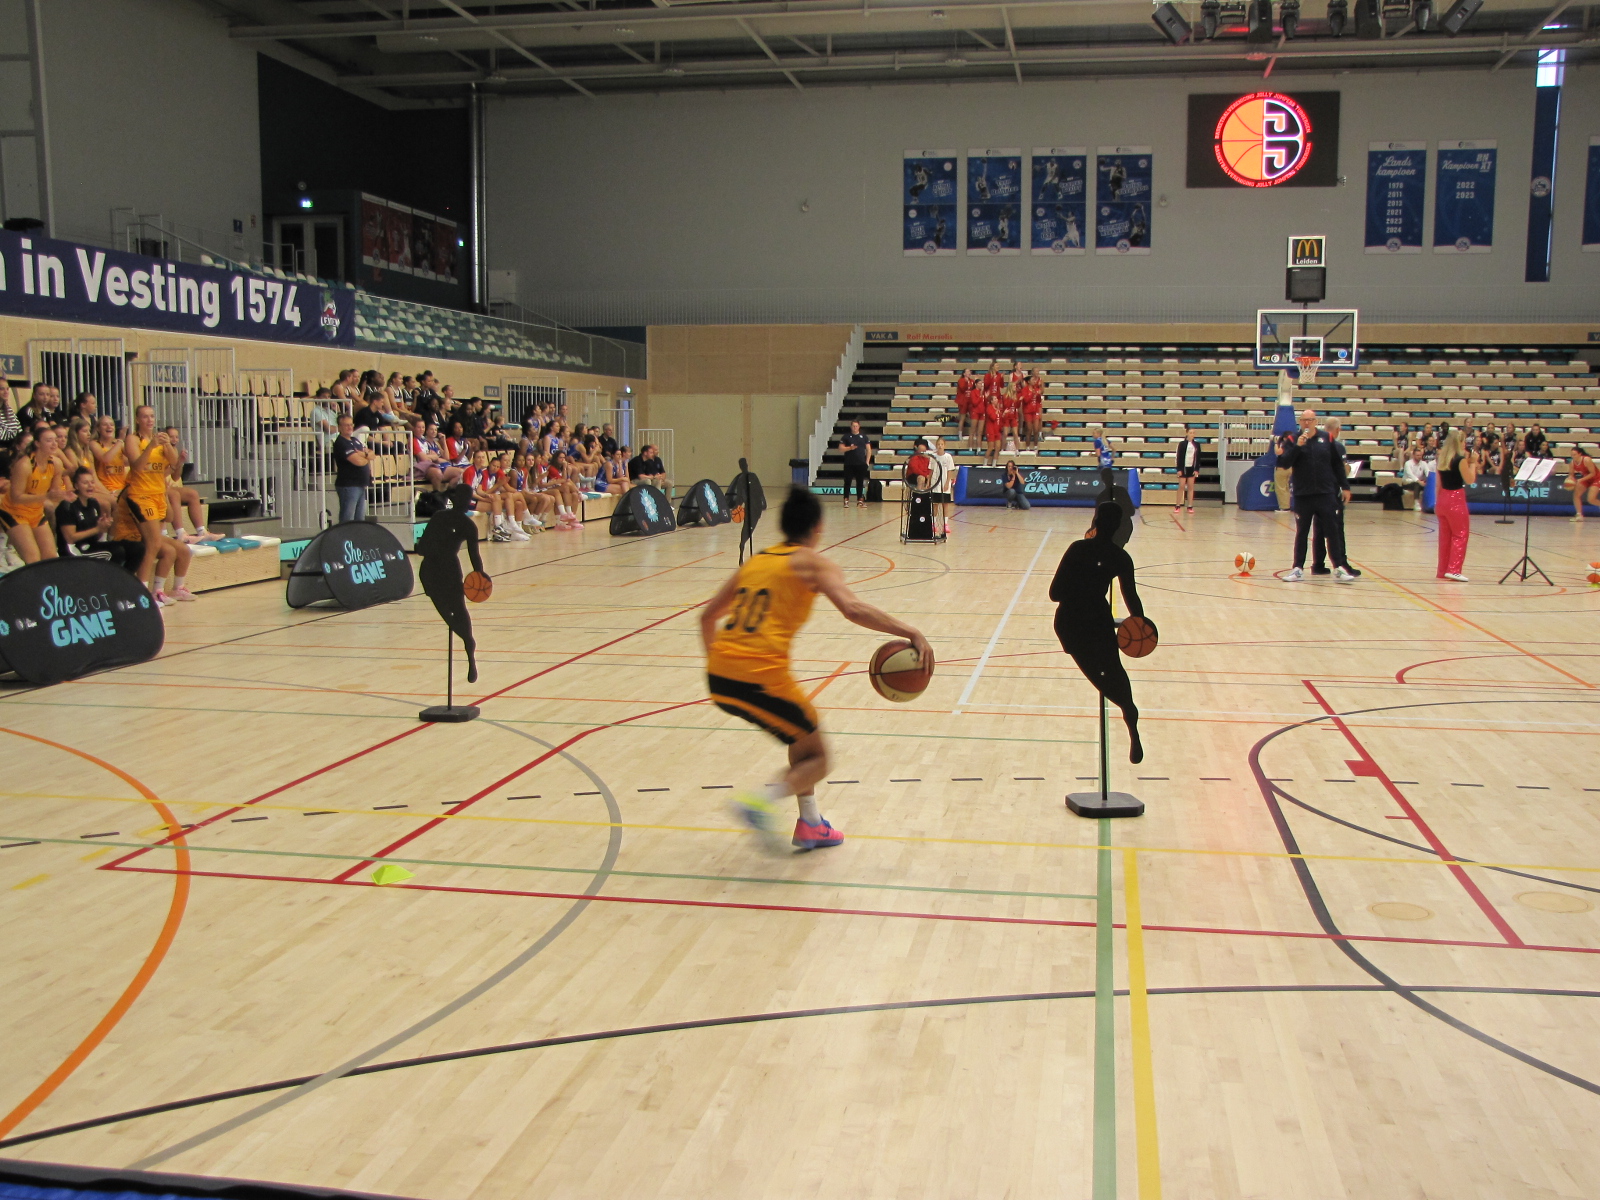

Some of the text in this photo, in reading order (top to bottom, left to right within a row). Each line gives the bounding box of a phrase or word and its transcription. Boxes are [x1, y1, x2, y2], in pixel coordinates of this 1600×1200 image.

[1382, 156, 1413, 167] Lands
[1442, 160, 1480, 172] Kampioen
[1376, 165, 1417, 178] kampioen
[1456, 191, 1475, 199] 2023
[21, 237, 67, 299] in
[75, 247, 221, 328] Vesting
[231, 276, 303, 327] 1574
[9, 358, 15, 371] F
[1024, 471, 1072, 484] She GOT
[1024, 483, 1069, 494] GAME
[145, 507, 155, 520] 10
[344, 540, 382, 565] She GOT
[350, 561, 387, 585] GAME
[40, 585, 110, 620] She GOT
[51, 610, 117, 648] GAME
